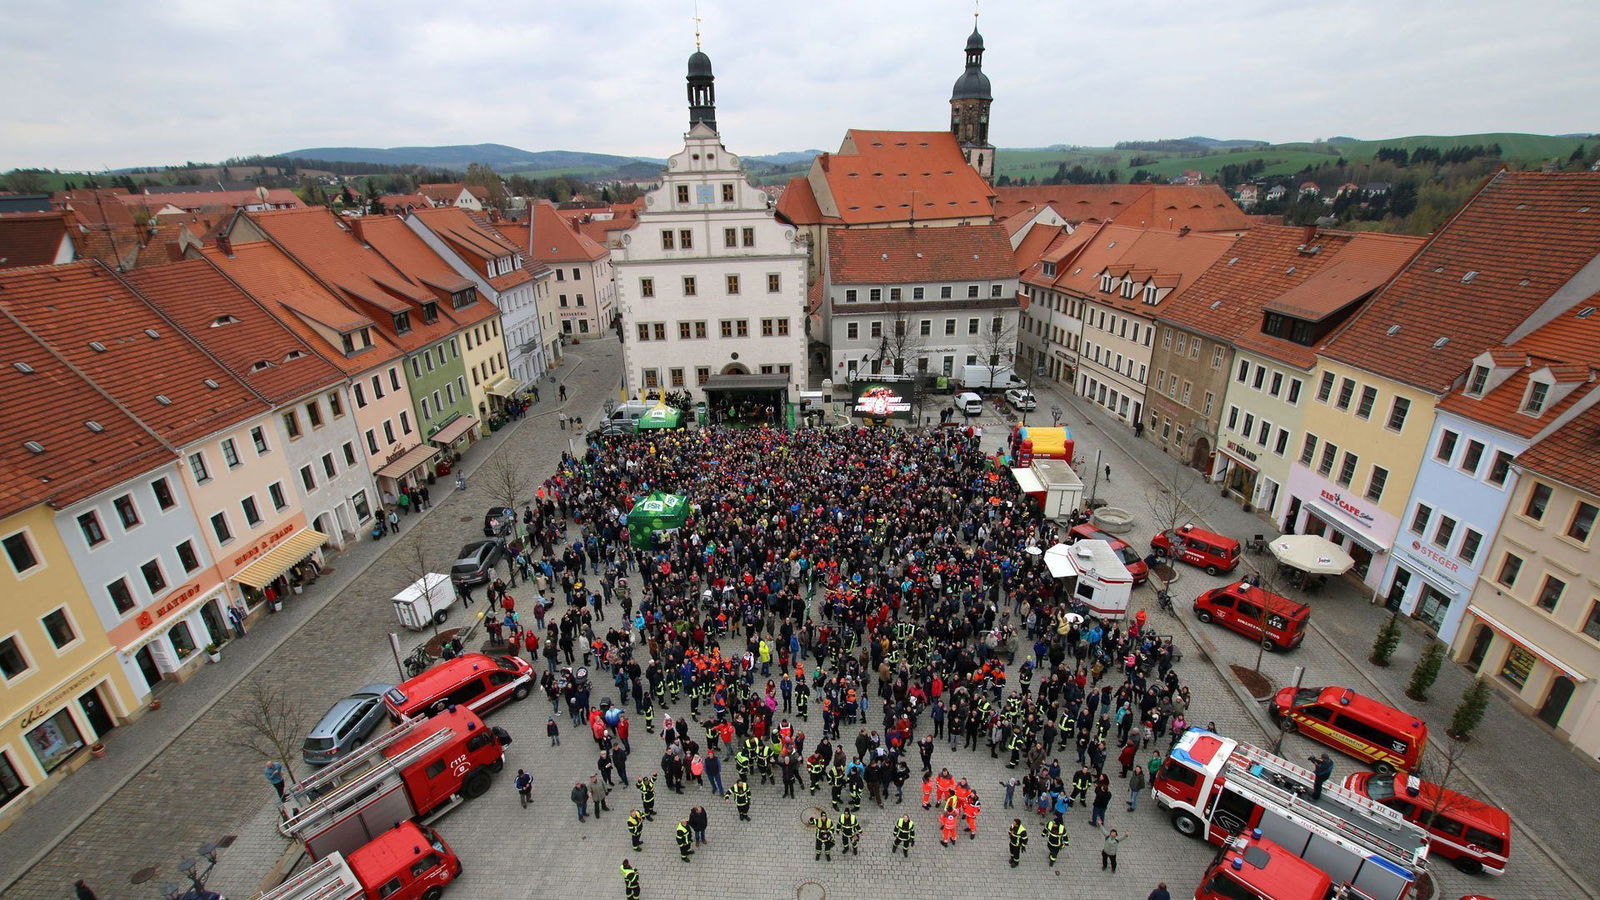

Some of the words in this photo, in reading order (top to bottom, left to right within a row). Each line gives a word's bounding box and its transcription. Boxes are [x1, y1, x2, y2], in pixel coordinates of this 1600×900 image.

[1320, 489, 1334, 501] EIS
[1420, 546, 1459, 572] STEGER
[156, 583, 201, 617] MAYHOF
[1267, 619, 1283, 630] 112
[1332, 731, 1366, 748] FEUERWEHR
[454, 754, 467, 766] 112
[1300, 820, 1329, 838] FEUERWEHR
